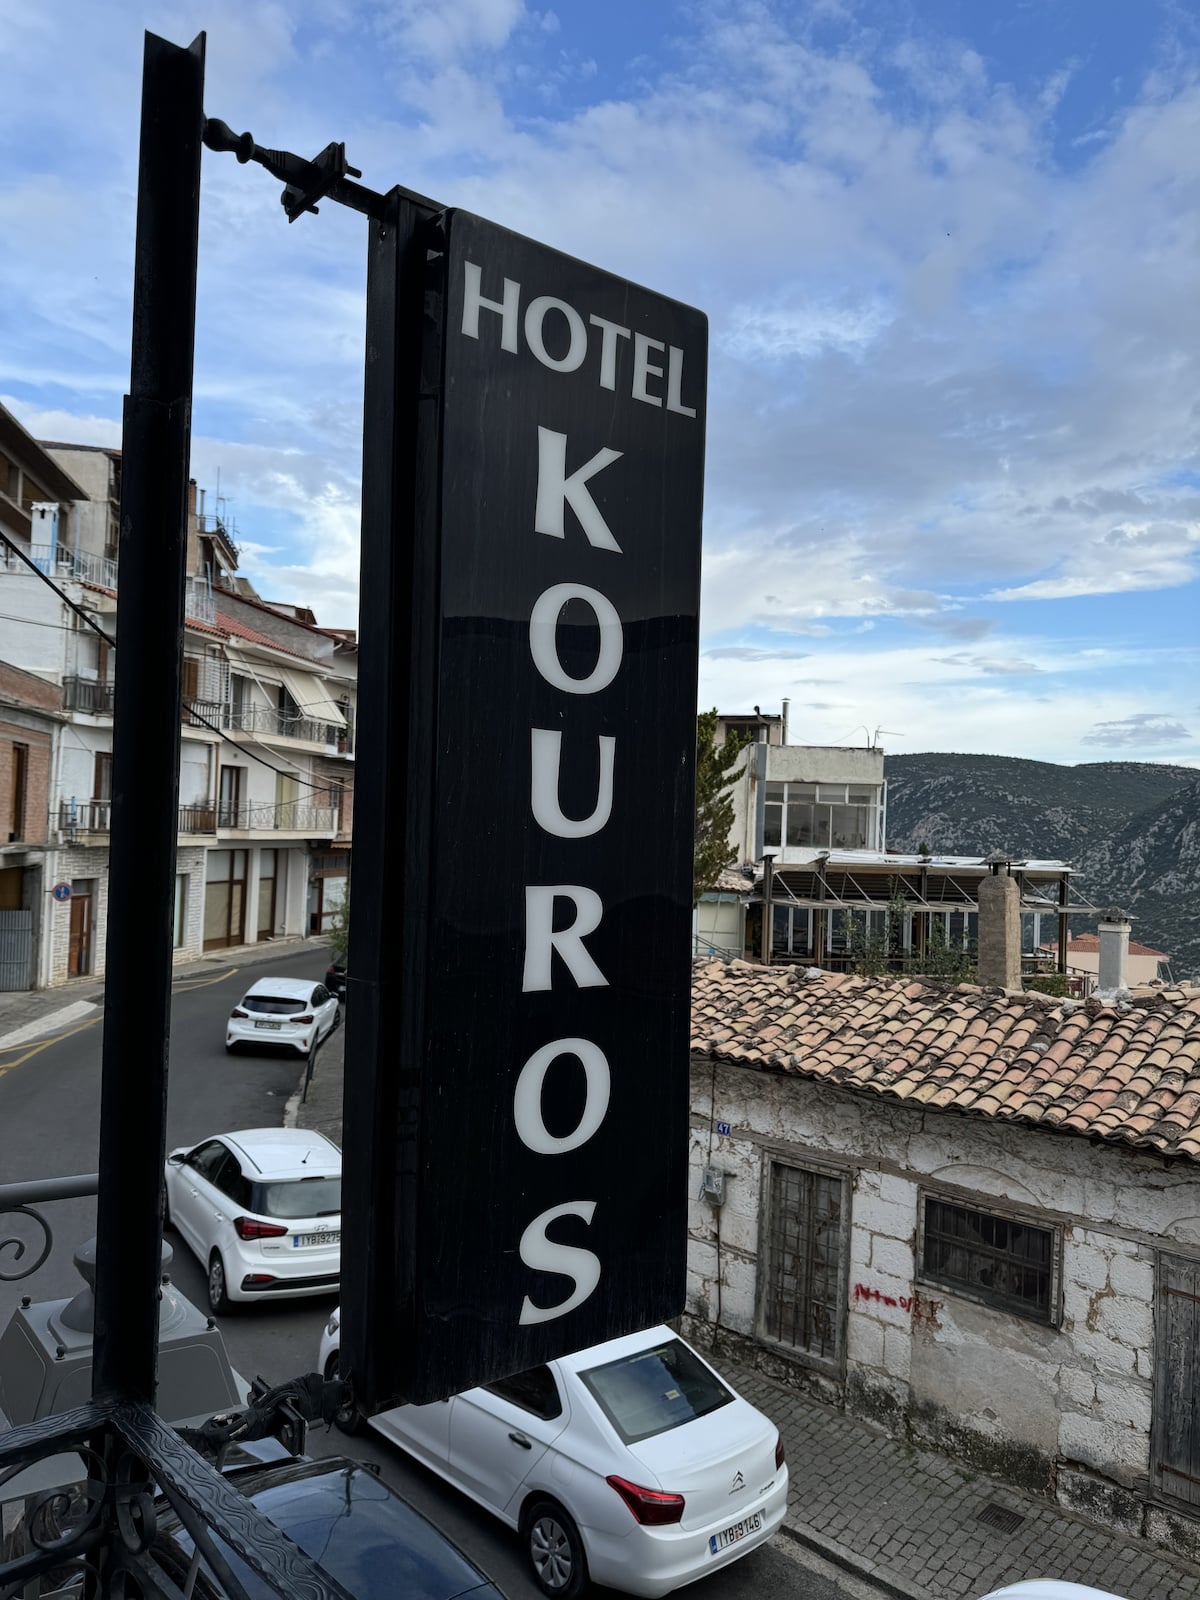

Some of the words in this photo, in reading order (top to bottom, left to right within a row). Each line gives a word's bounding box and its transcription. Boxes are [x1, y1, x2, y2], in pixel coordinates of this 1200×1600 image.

[461, 260, 697, 419] HOTEL
[513, 425, 624, 1326] KOUROS
[718, 1122, 729, 1135] 47
